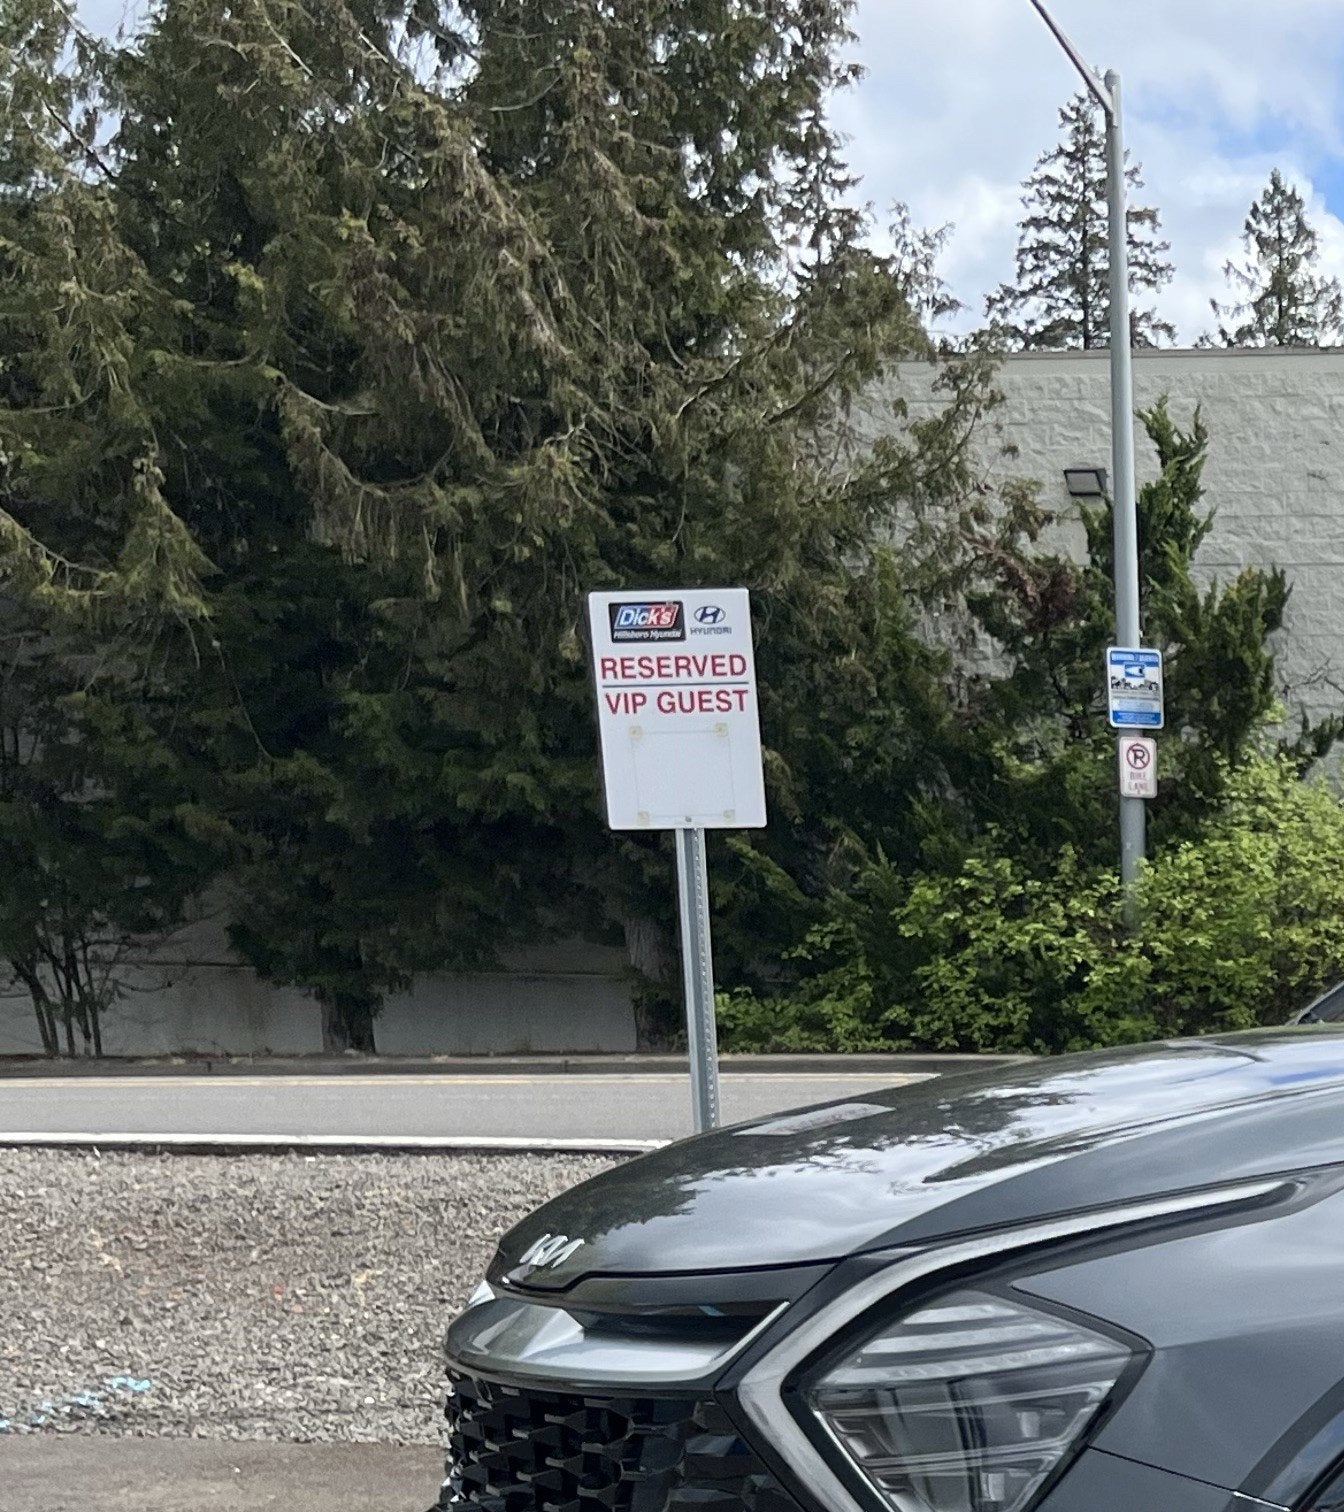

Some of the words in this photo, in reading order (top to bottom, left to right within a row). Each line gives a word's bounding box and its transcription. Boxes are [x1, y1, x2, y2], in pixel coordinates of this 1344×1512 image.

[619, 609, 672, 626] Dick's
[601, 654, 747, 680] RESERVED
[605, 692, 647, 715] VIP
[656, 689, 748, 715] GUEST
